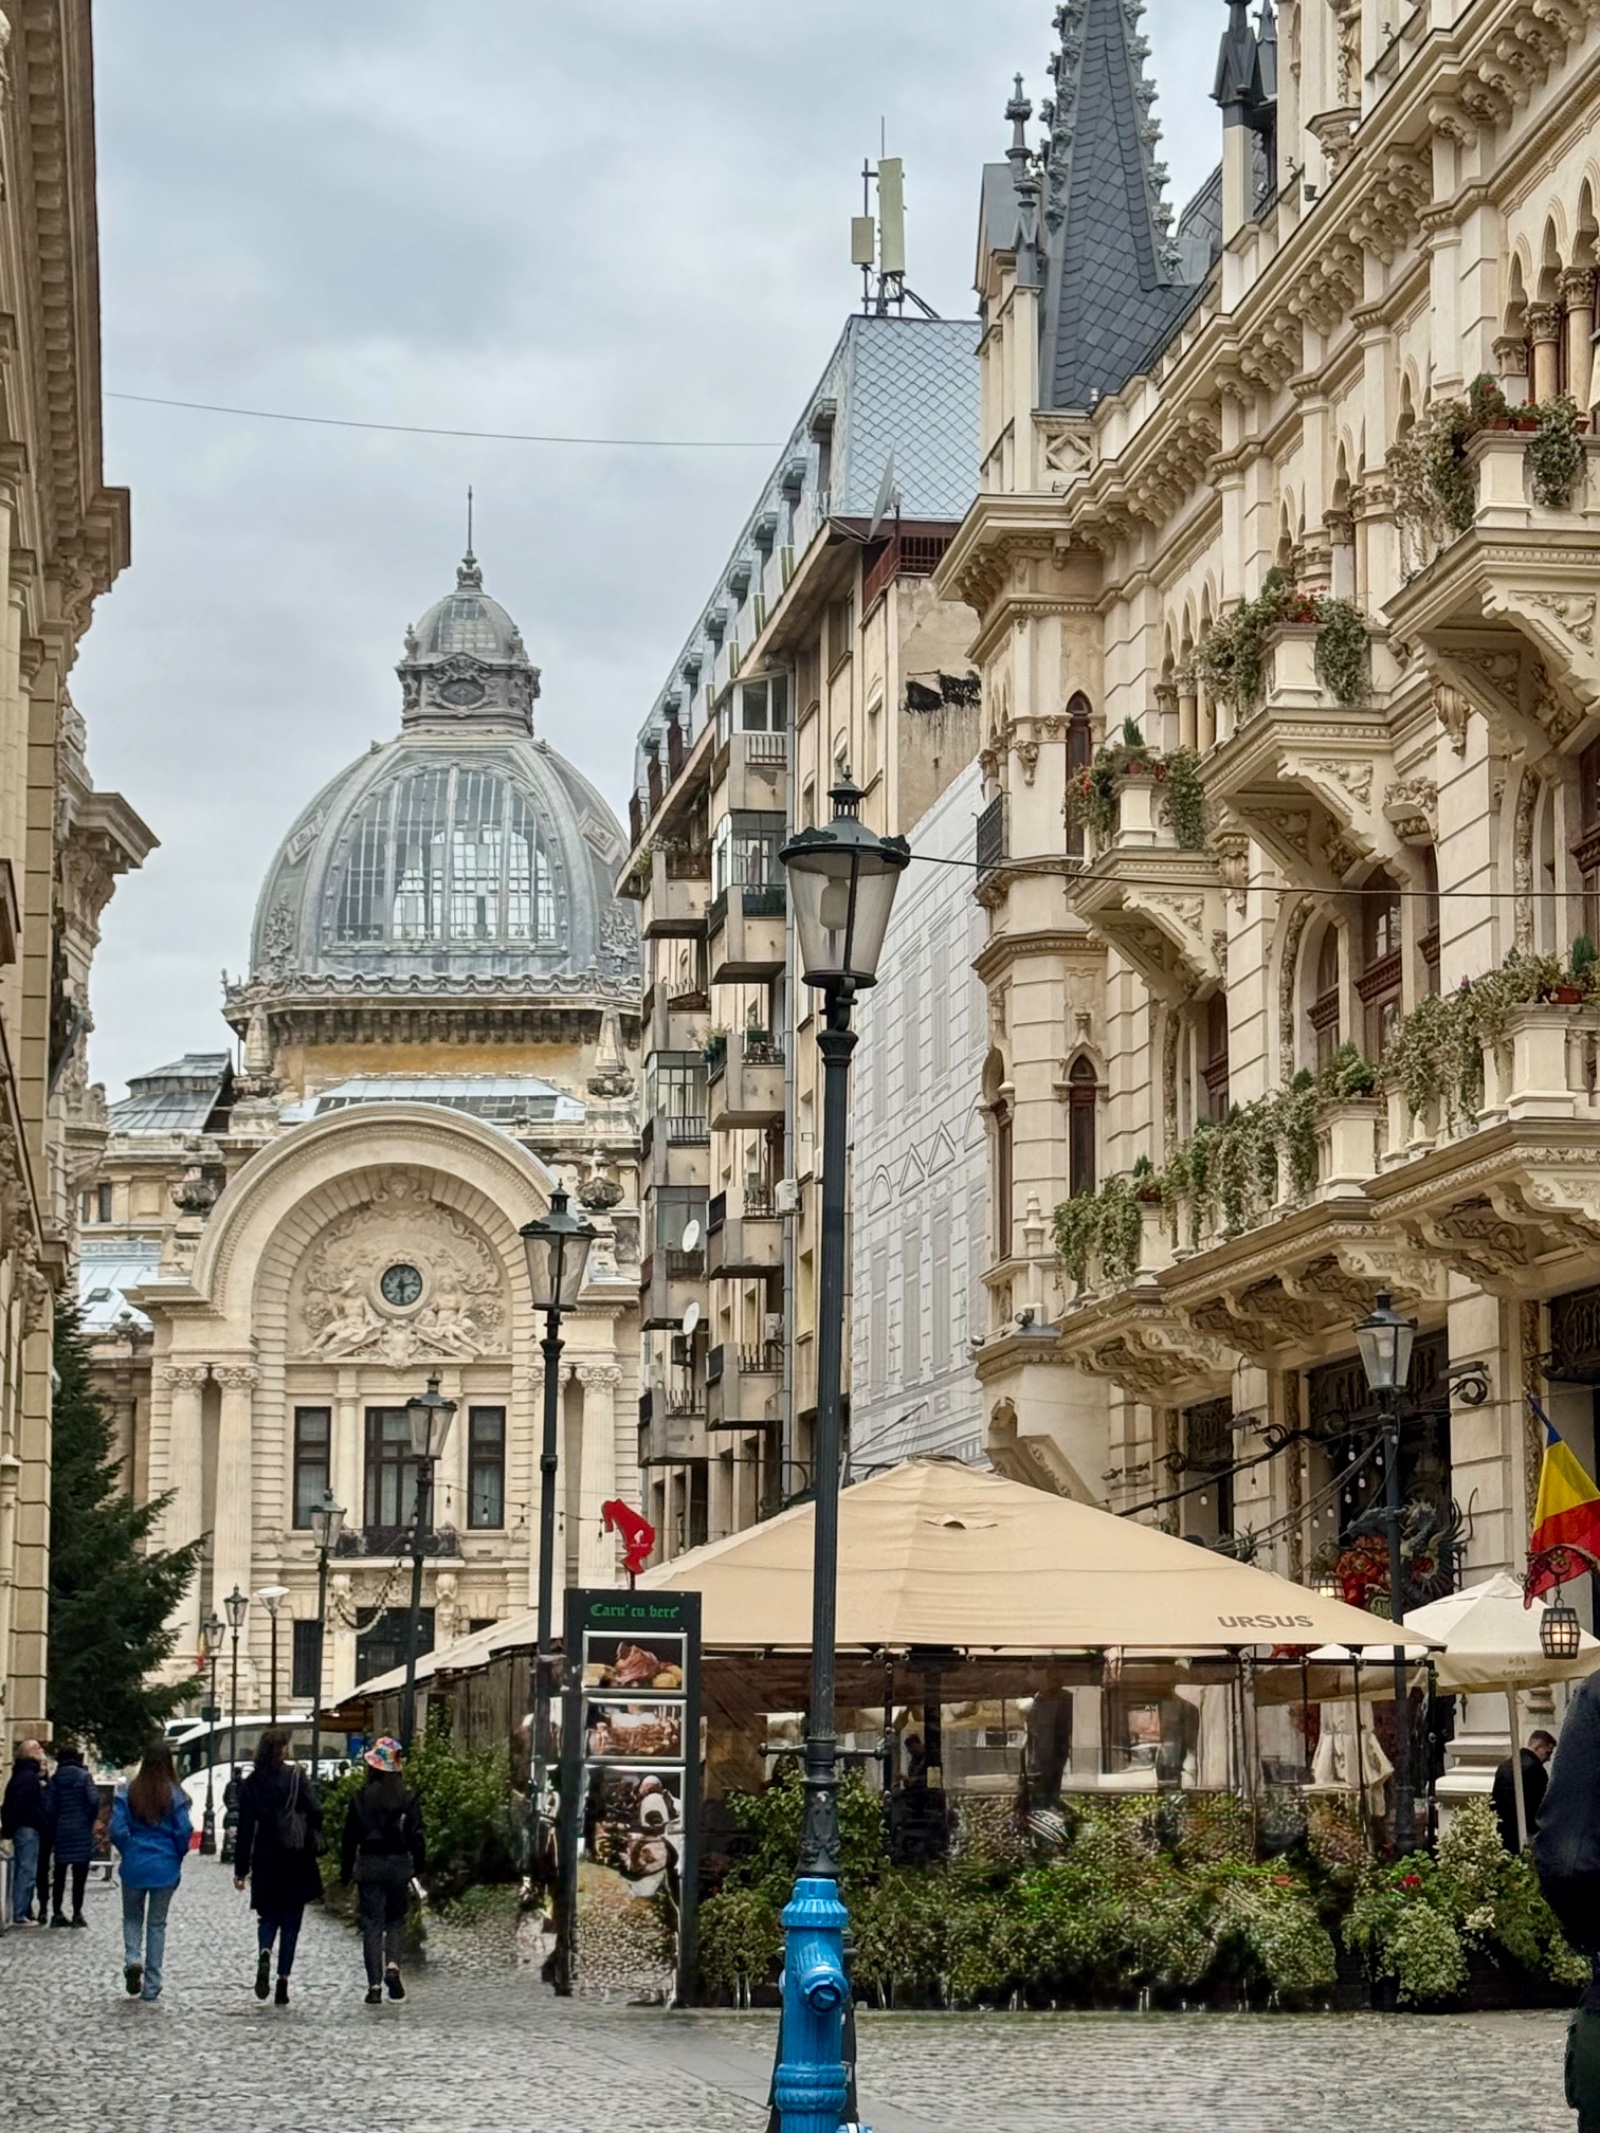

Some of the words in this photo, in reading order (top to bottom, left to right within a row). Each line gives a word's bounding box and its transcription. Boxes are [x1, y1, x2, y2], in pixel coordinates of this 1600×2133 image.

[590, 1603, 629, 1617] Caru'
[631, 1606, 646, 1618] cu
[1217, 1615, 1314, 1629] URSUS
